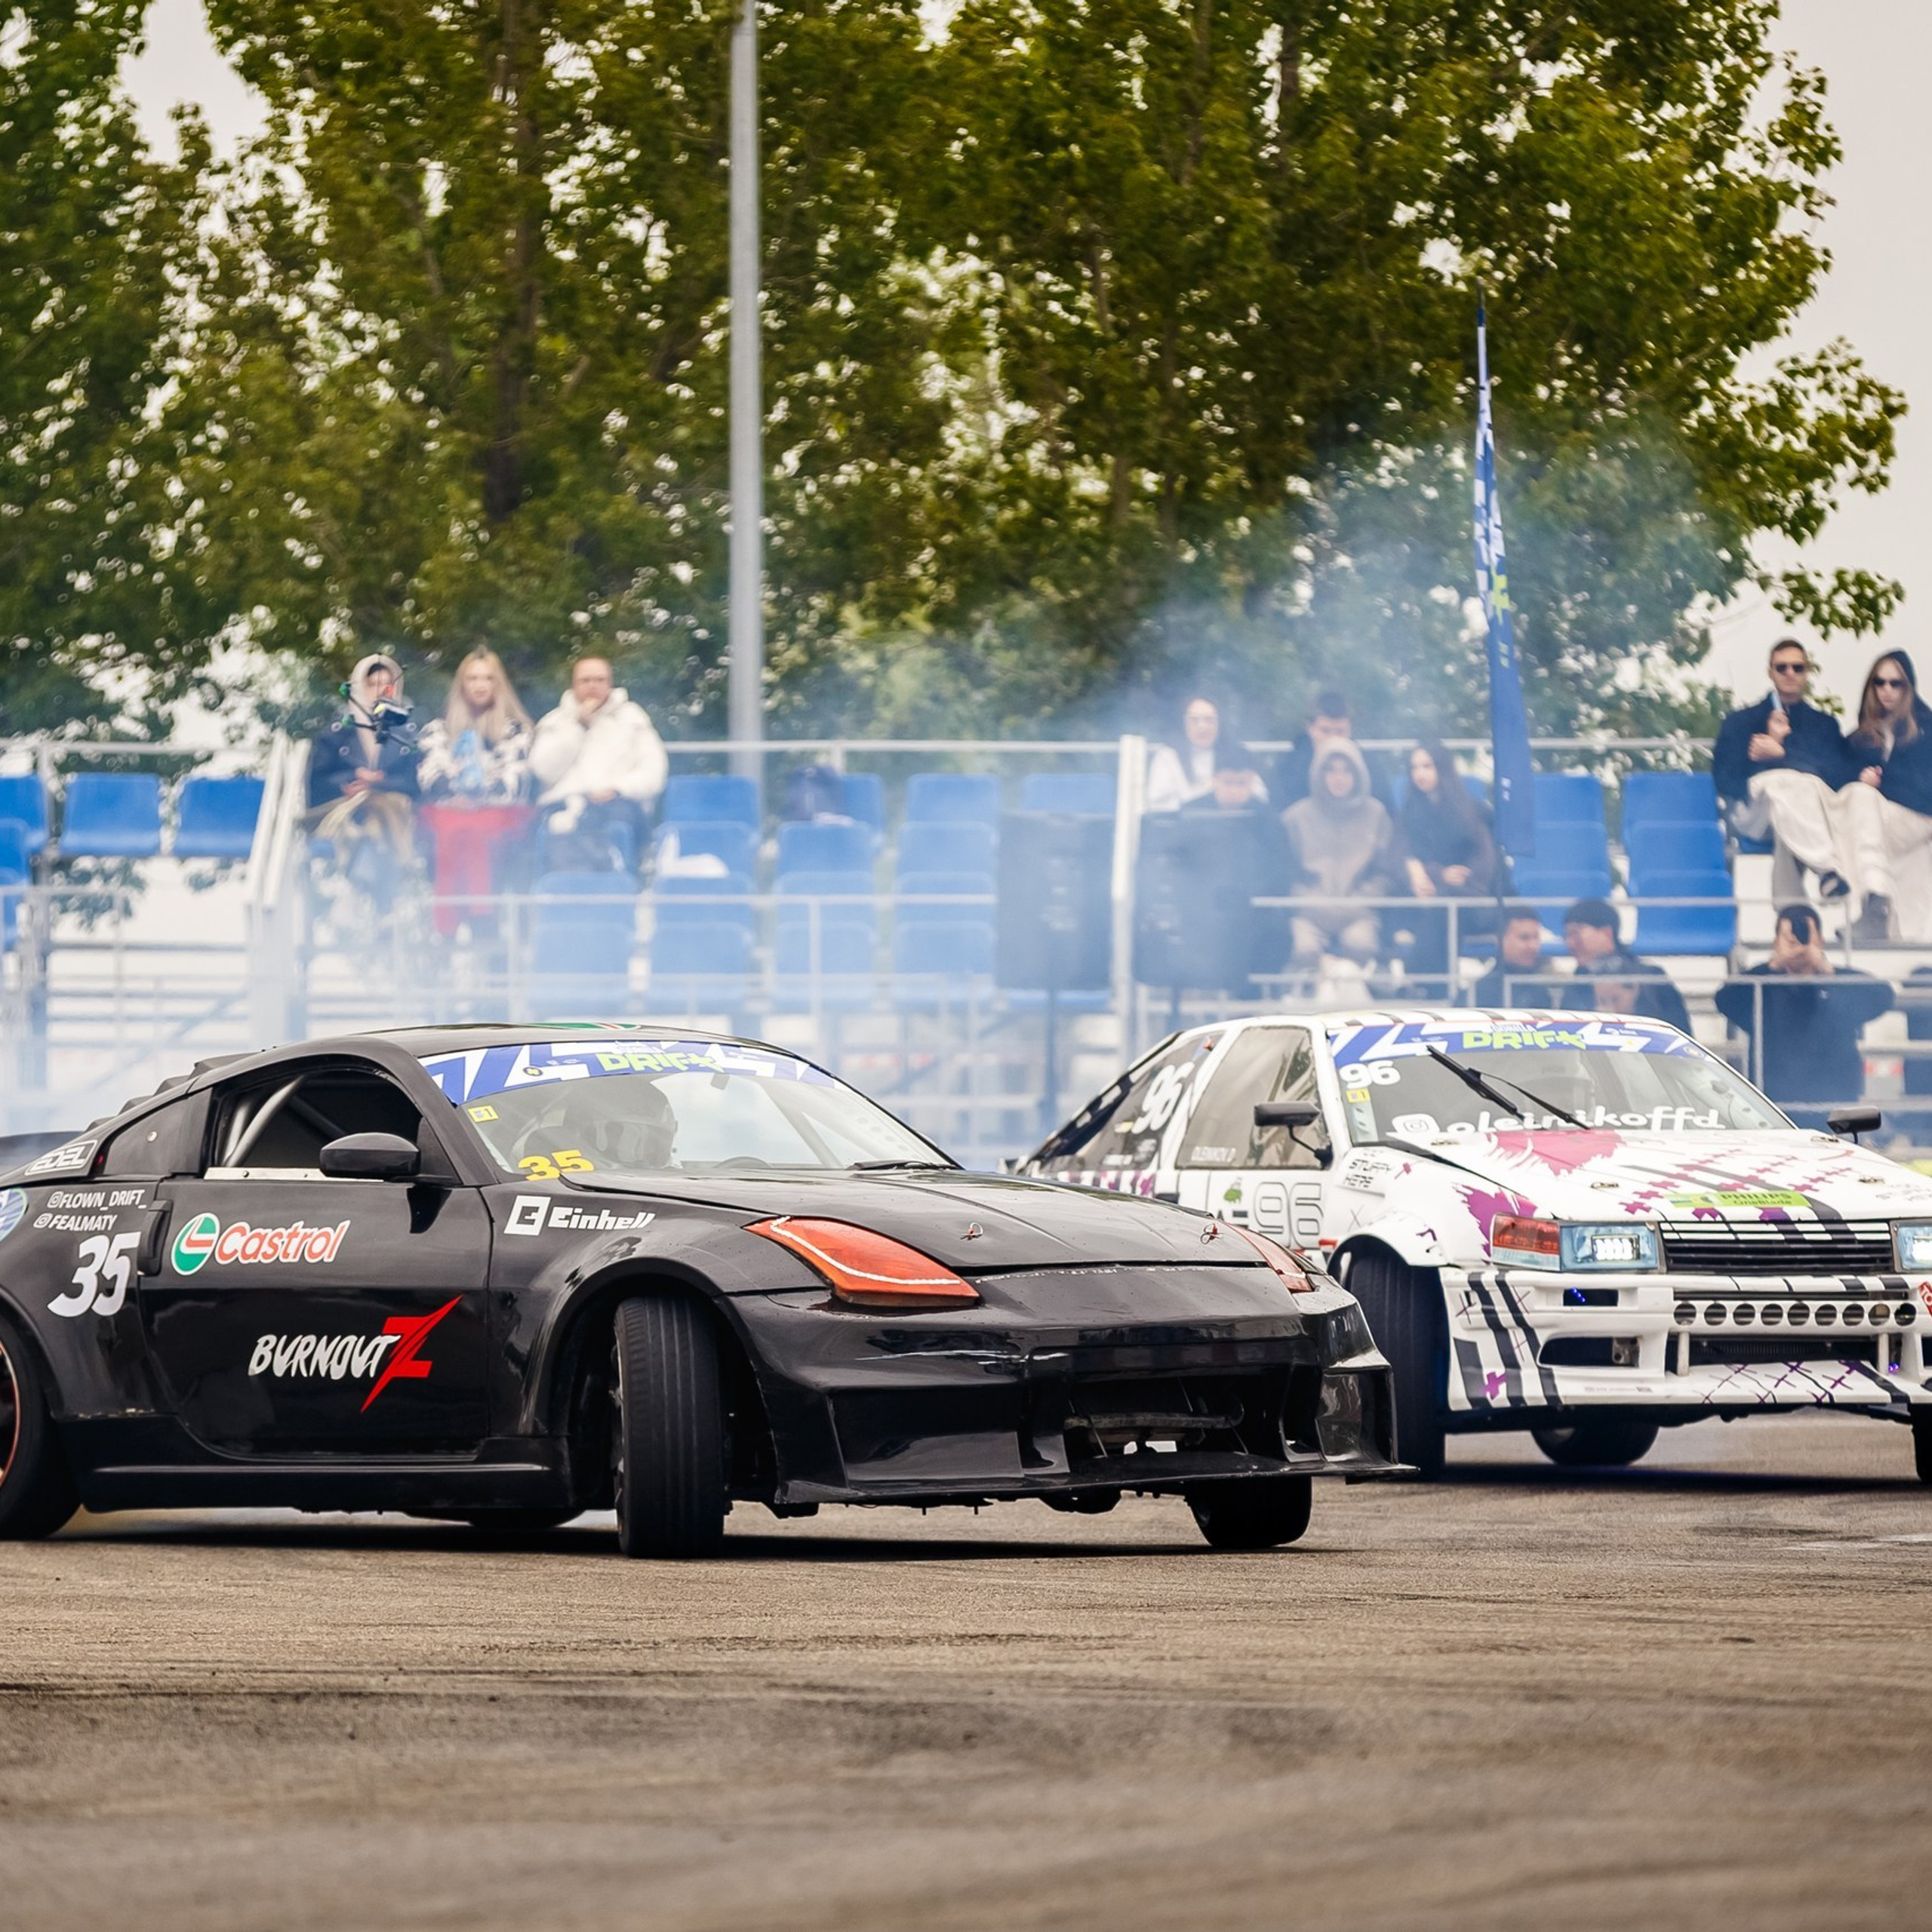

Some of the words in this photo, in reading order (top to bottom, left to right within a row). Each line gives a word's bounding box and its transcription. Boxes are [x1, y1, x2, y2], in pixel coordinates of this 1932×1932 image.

[1339, 1060, 1401, 1089] 96
[1131, 1061, 1195, 1135] 96
[518, 1149, 595, 1181] 35
[48, 1214, 118, 1232] FEALMATY
[547, 1206, 656, 1230] Einhell
[1254, 1181, 1324, 1251] 96
[215, 1220, 351, 1264] Castrol
[46, 1231, 142, 1318] 35
